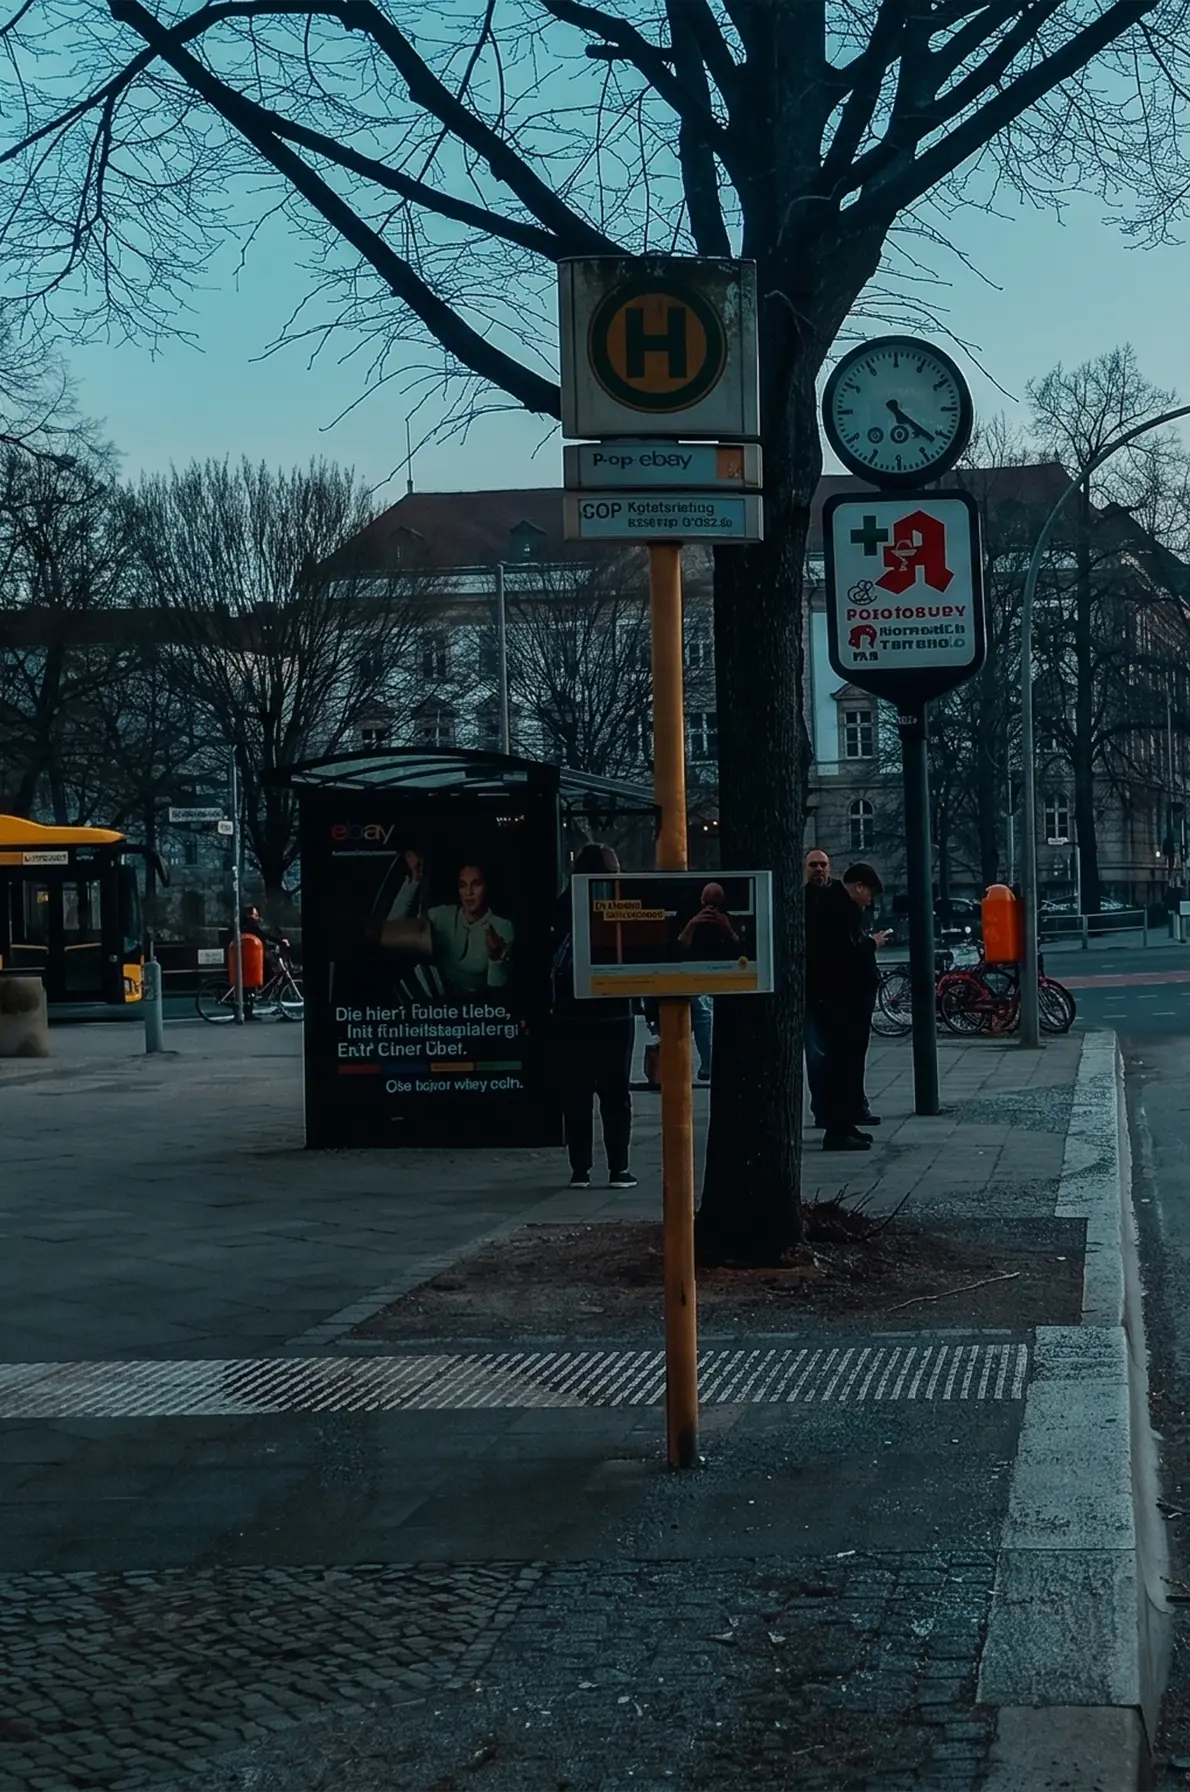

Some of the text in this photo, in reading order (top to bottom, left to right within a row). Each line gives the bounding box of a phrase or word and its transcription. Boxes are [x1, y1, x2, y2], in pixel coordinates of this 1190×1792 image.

[625, 307, 687, 379] H
[331, 819, 395, 845] ebay
[335, 1006, 363, 1021] Die
